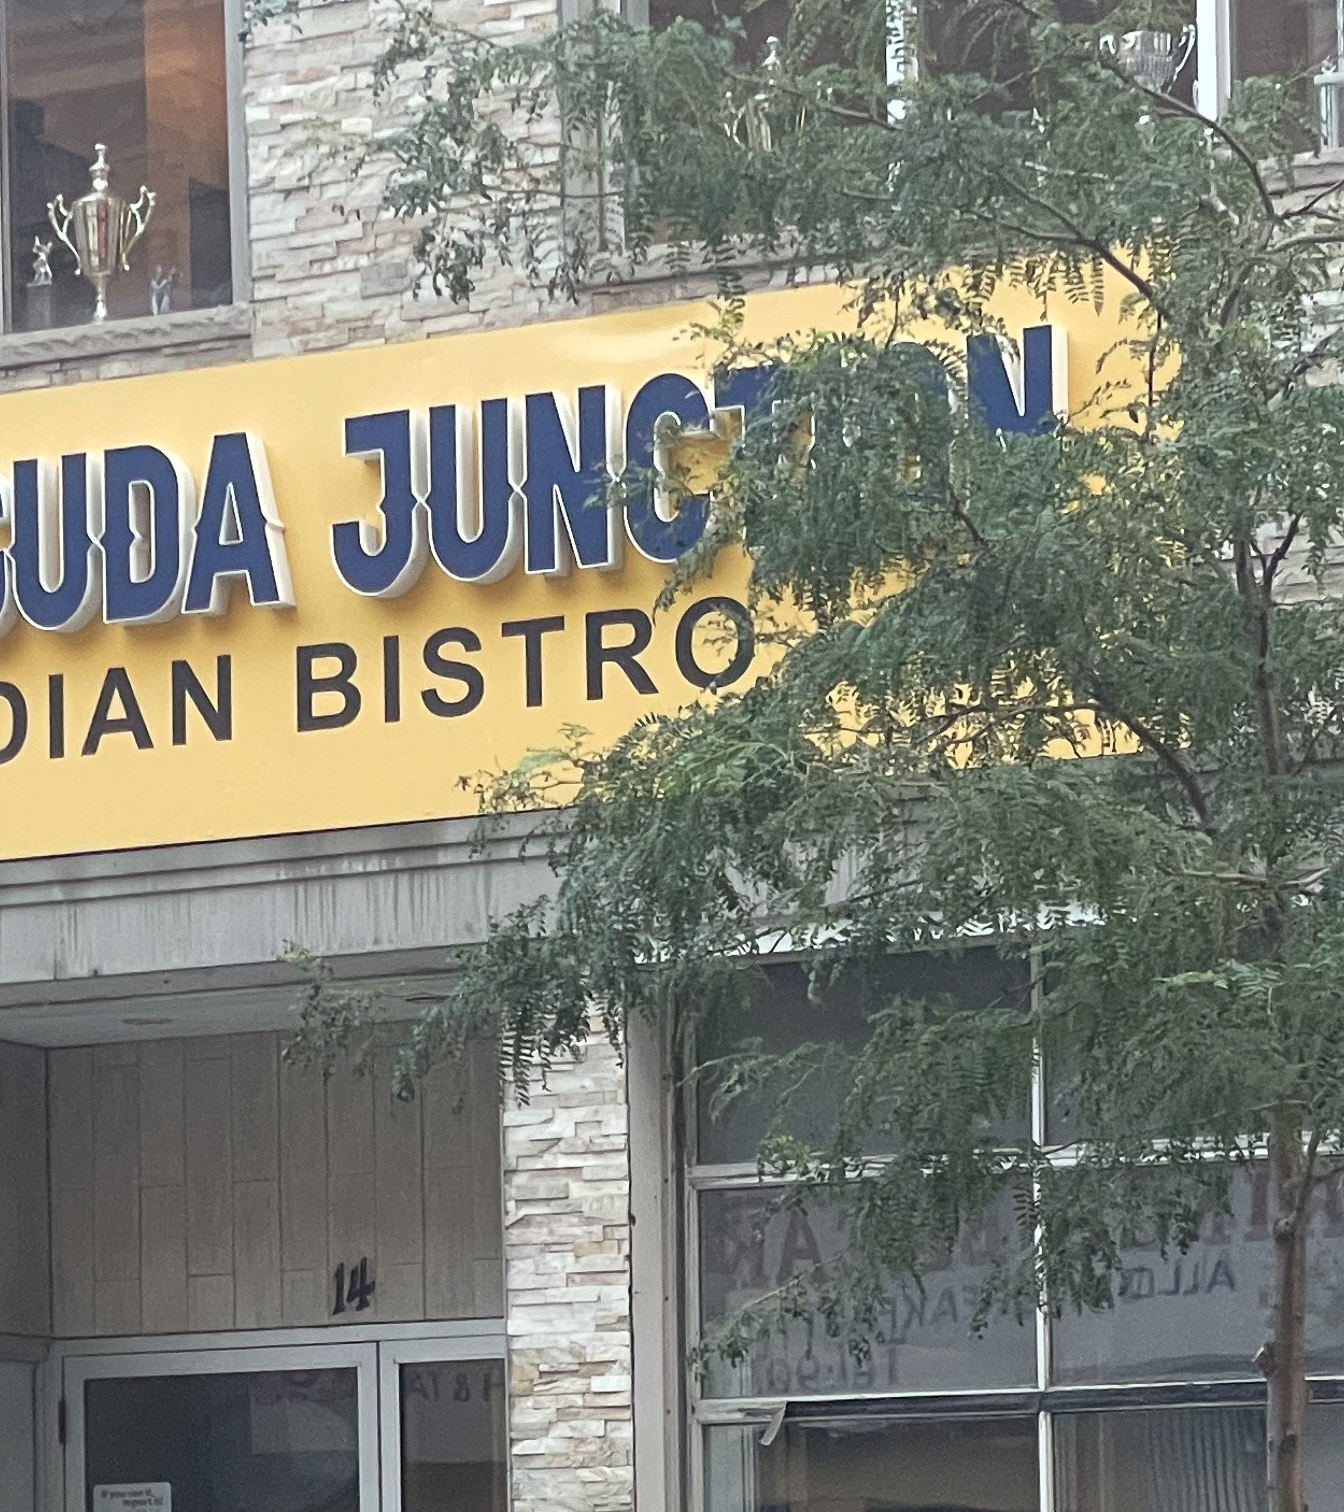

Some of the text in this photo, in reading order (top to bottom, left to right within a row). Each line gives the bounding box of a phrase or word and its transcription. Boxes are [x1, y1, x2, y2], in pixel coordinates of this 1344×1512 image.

[332, 324, 1064, 598] JUNCN
[296, 596, 755, 733] BISTRO
[332, 1256, 376, 1316] 14
